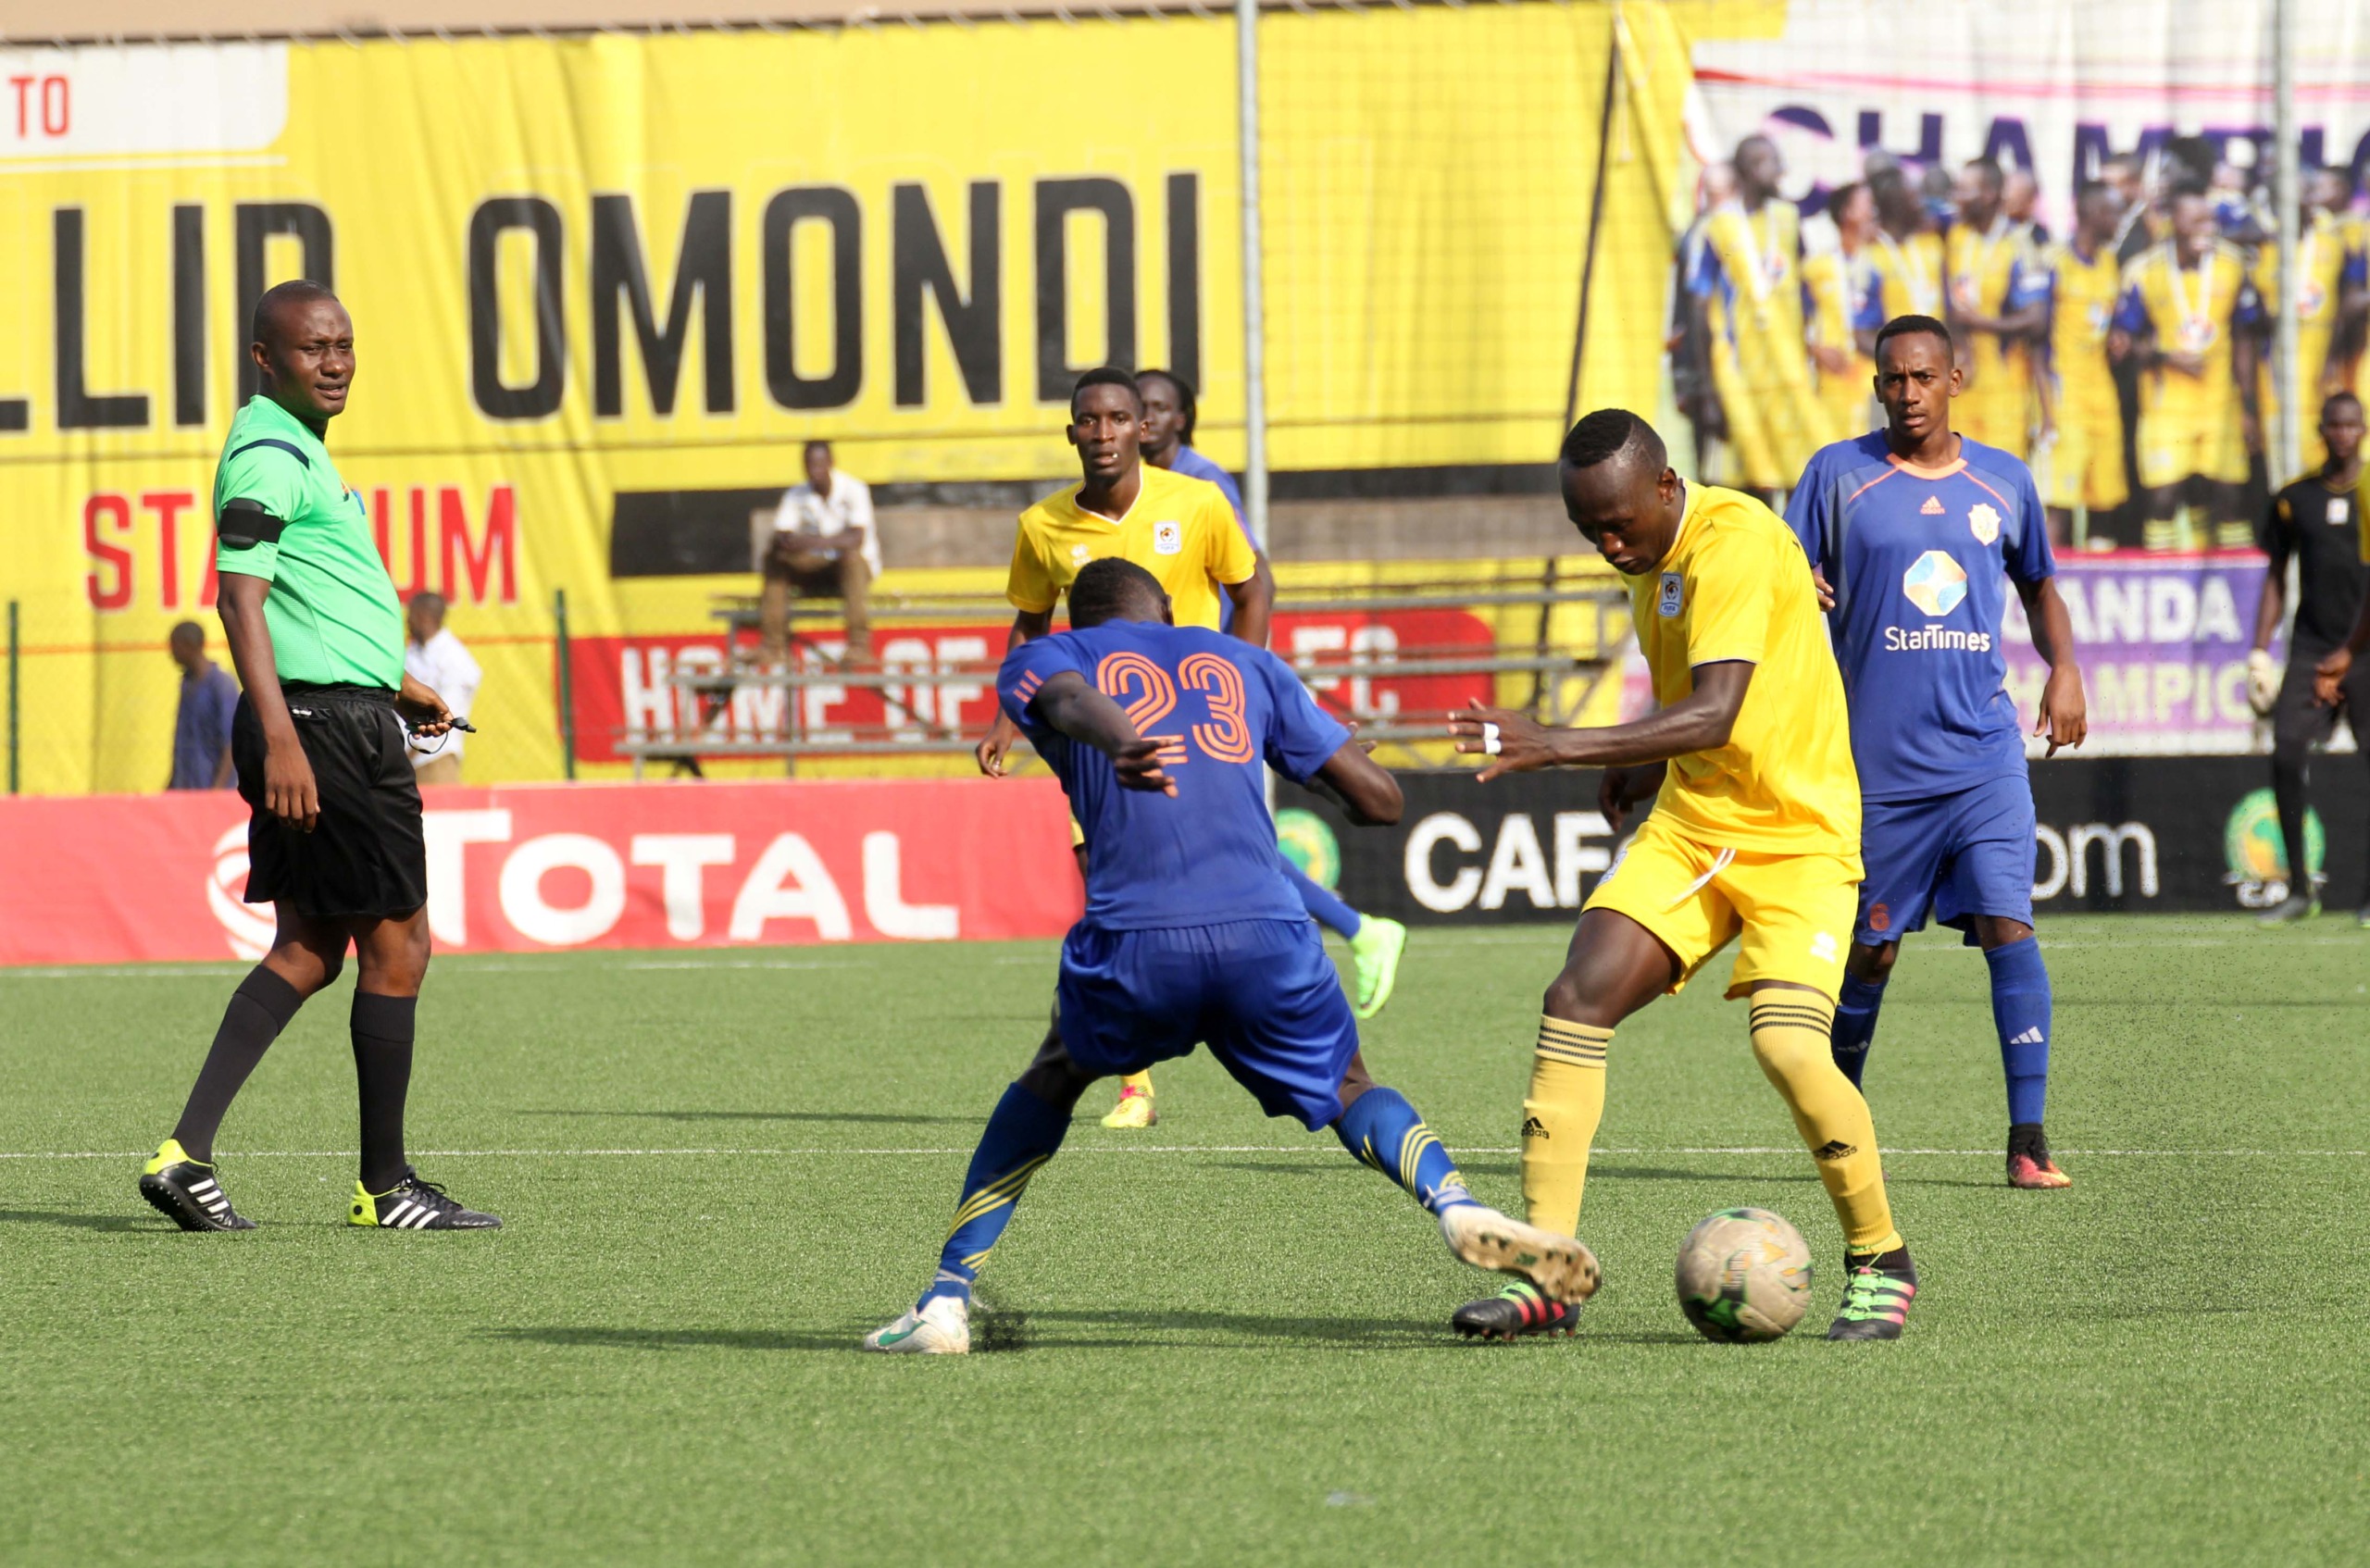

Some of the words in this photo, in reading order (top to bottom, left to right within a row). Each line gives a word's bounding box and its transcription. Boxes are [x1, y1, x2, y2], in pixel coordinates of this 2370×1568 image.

[9, 75, 70, 137] TO
[468, 173, 1199, 419] OMONDI
[84, 487, 516, 611] STUM
[621, 643, 854, 743] HOME
[880, 638, 988, 740] OF
[1292, 626, 1399, 728] FC
[1885, 624, 1990, 652] StarTimes
[1096, 651, 1254, 765] 23
[422, 808, 959, 947] TOTAL
